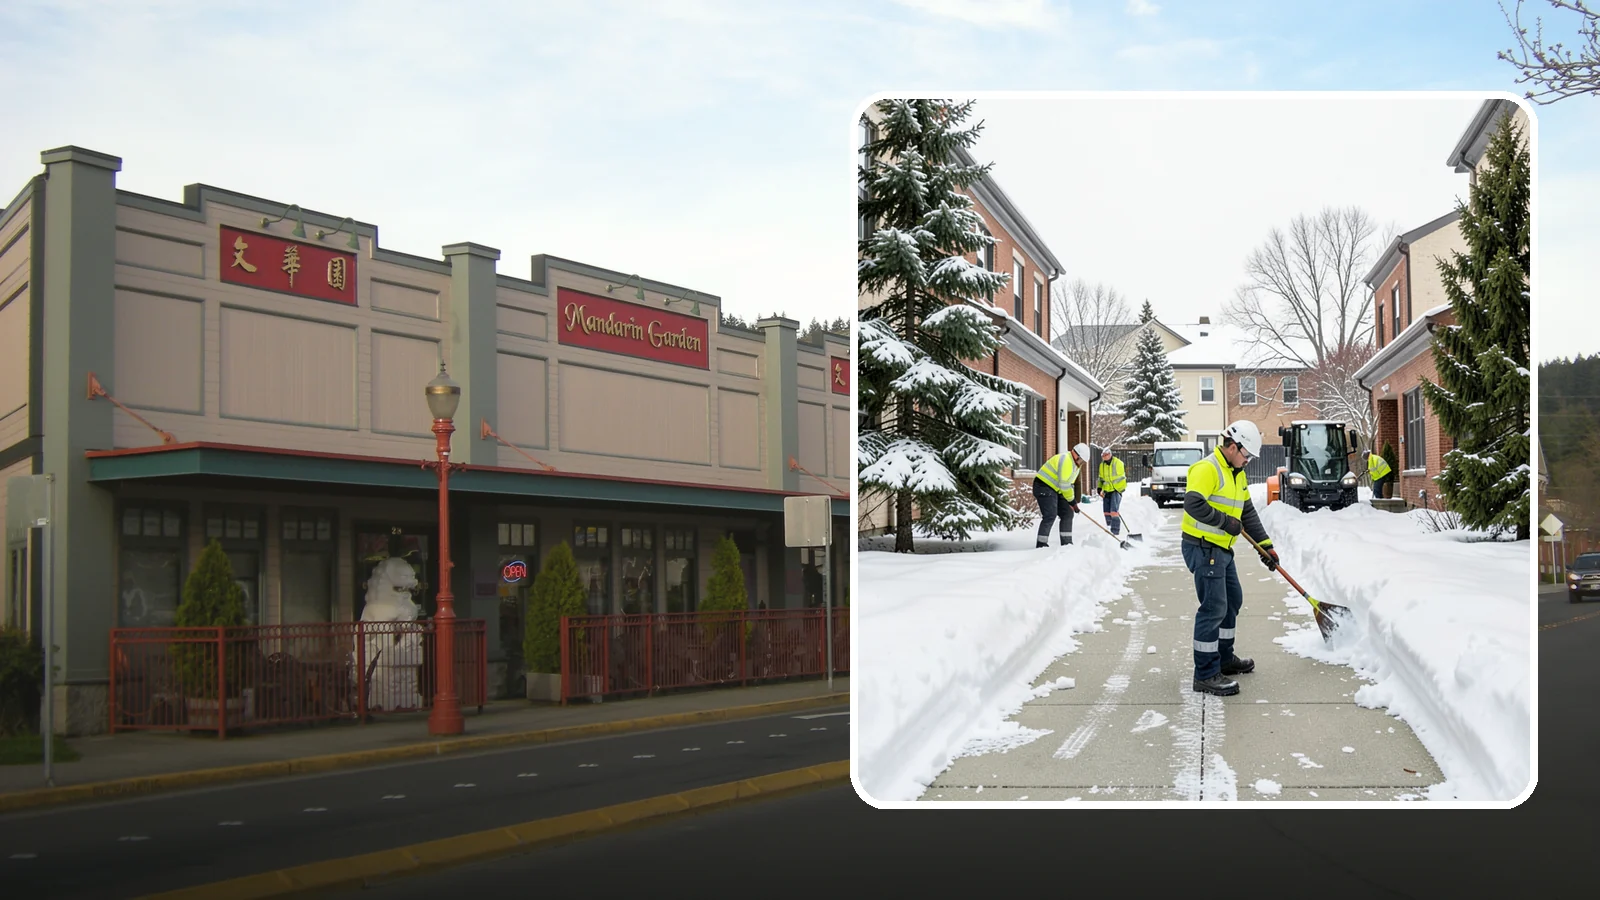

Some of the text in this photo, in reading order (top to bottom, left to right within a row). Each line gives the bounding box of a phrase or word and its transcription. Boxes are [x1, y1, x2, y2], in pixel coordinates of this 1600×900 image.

[231, 236, 346, 290] 文華園
[564, 302, 701, 351] Mandarin Garden
[503, 565, 527, 578] OPEN
